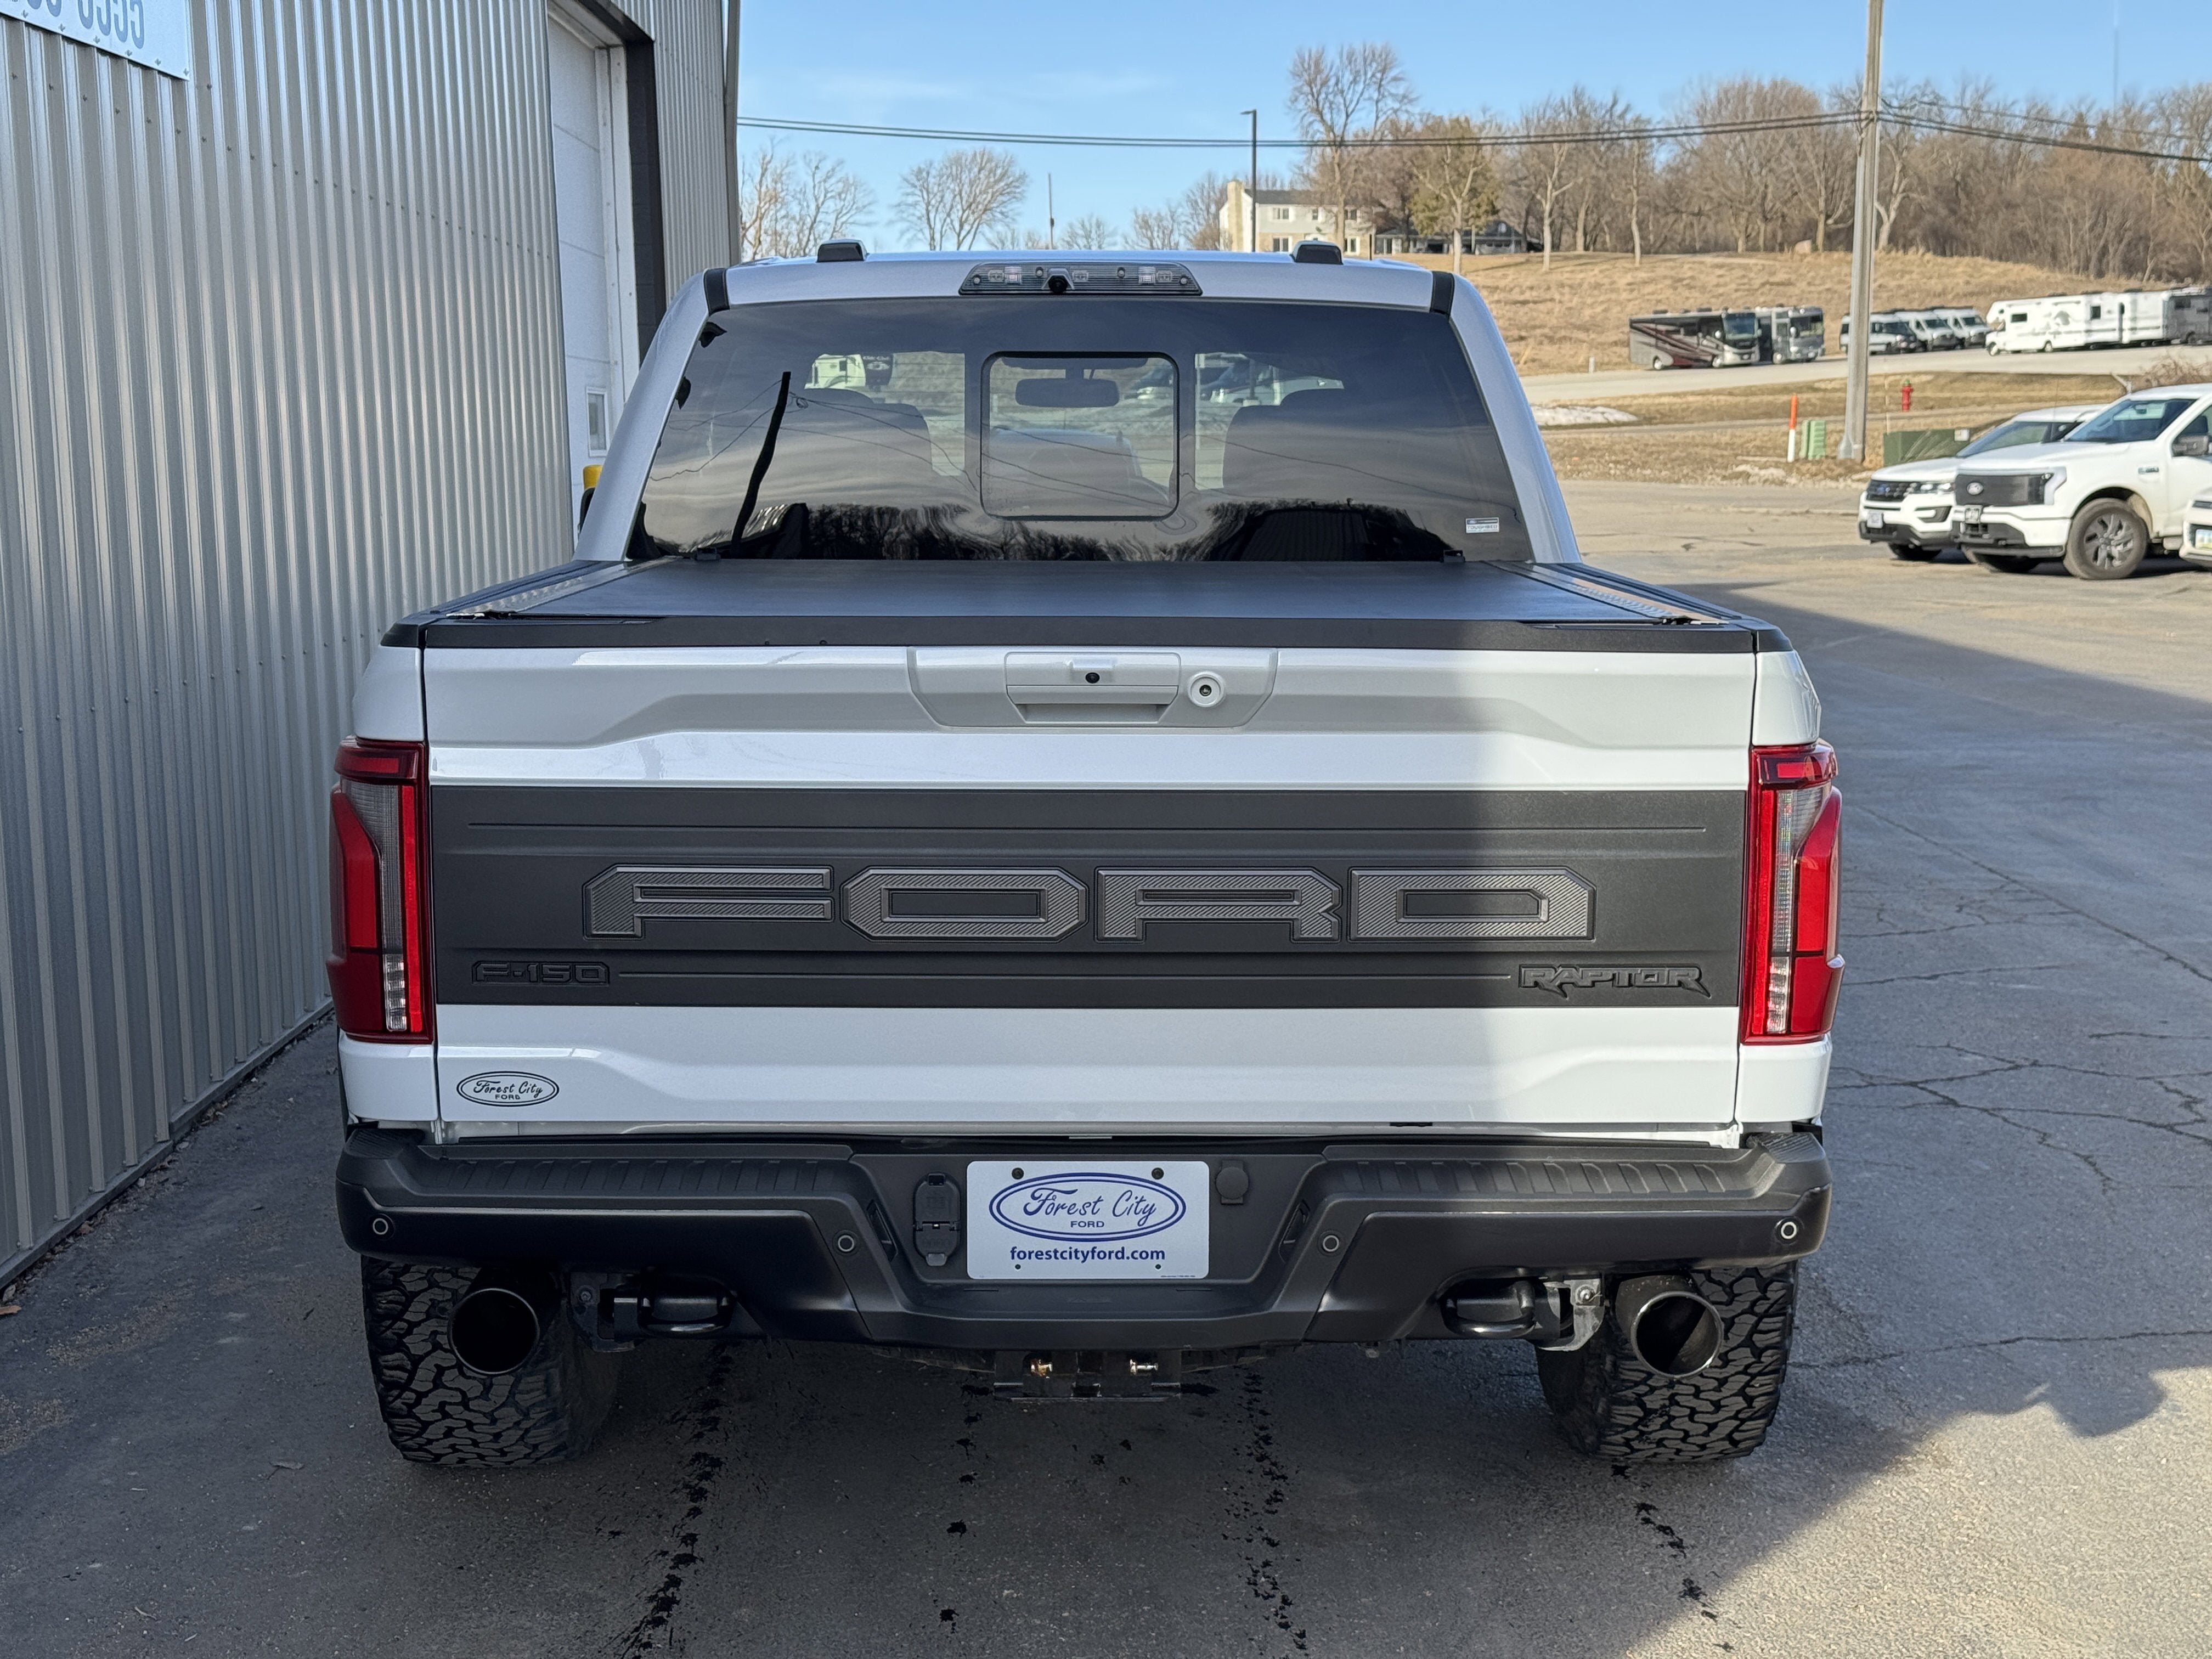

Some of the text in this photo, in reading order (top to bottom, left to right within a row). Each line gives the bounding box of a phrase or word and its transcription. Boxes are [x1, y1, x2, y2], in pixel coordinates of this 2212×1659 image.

[584, 865, 1596, 941] FORD
[474, 962, 609, 984] F-150
[1519, 964, 1712, 999] RAPTOR
[473, 1080, 543, 1098] Forest City
[1023, 1187, 1156, 1227] Forest City
[1010, 1246, 1165, 1263] forestcityford.com
